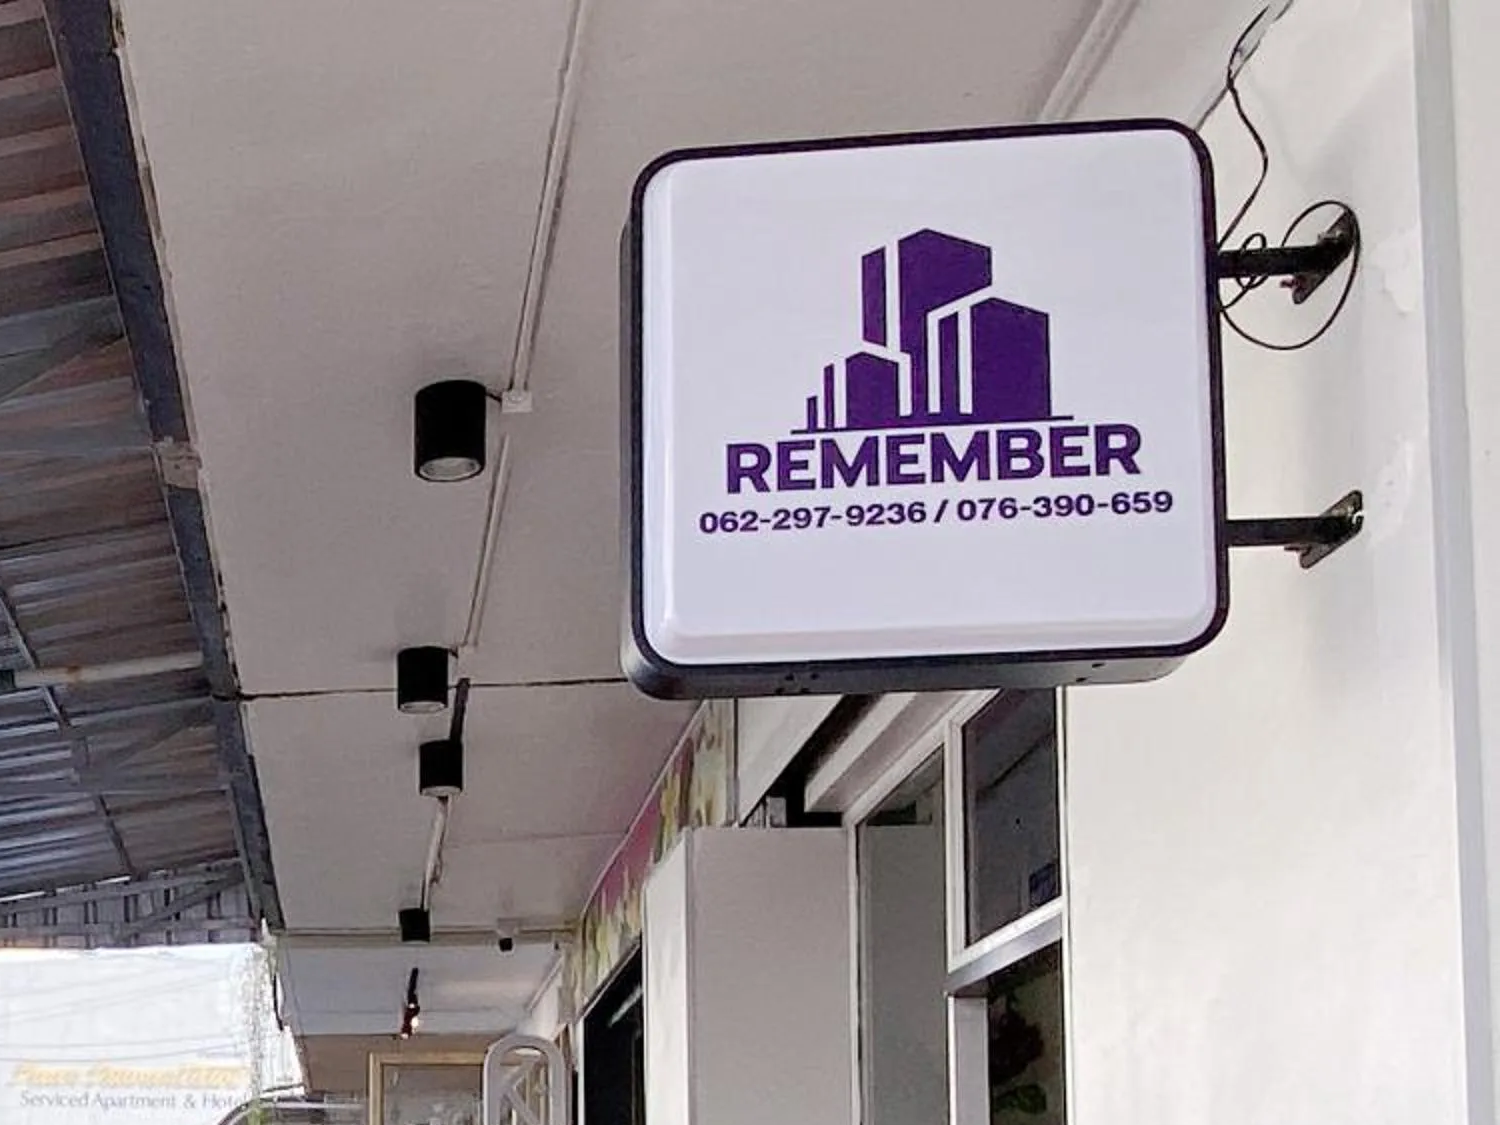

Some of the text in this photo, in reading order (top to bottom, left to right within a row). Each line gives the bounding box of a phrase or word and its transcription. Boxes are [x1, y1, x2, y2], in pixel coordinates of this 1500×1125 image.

[726, 424, 1142, 494] REMEMBER
[699, 502, 927, 534] 062-297-9236
[957, 490, 1173, 521] 076-390-659
[20, 1089, 89, 1108] Serviced
[96, 1092, 177, 1112] Apartment
[182, 1093, 197, 1109] &
